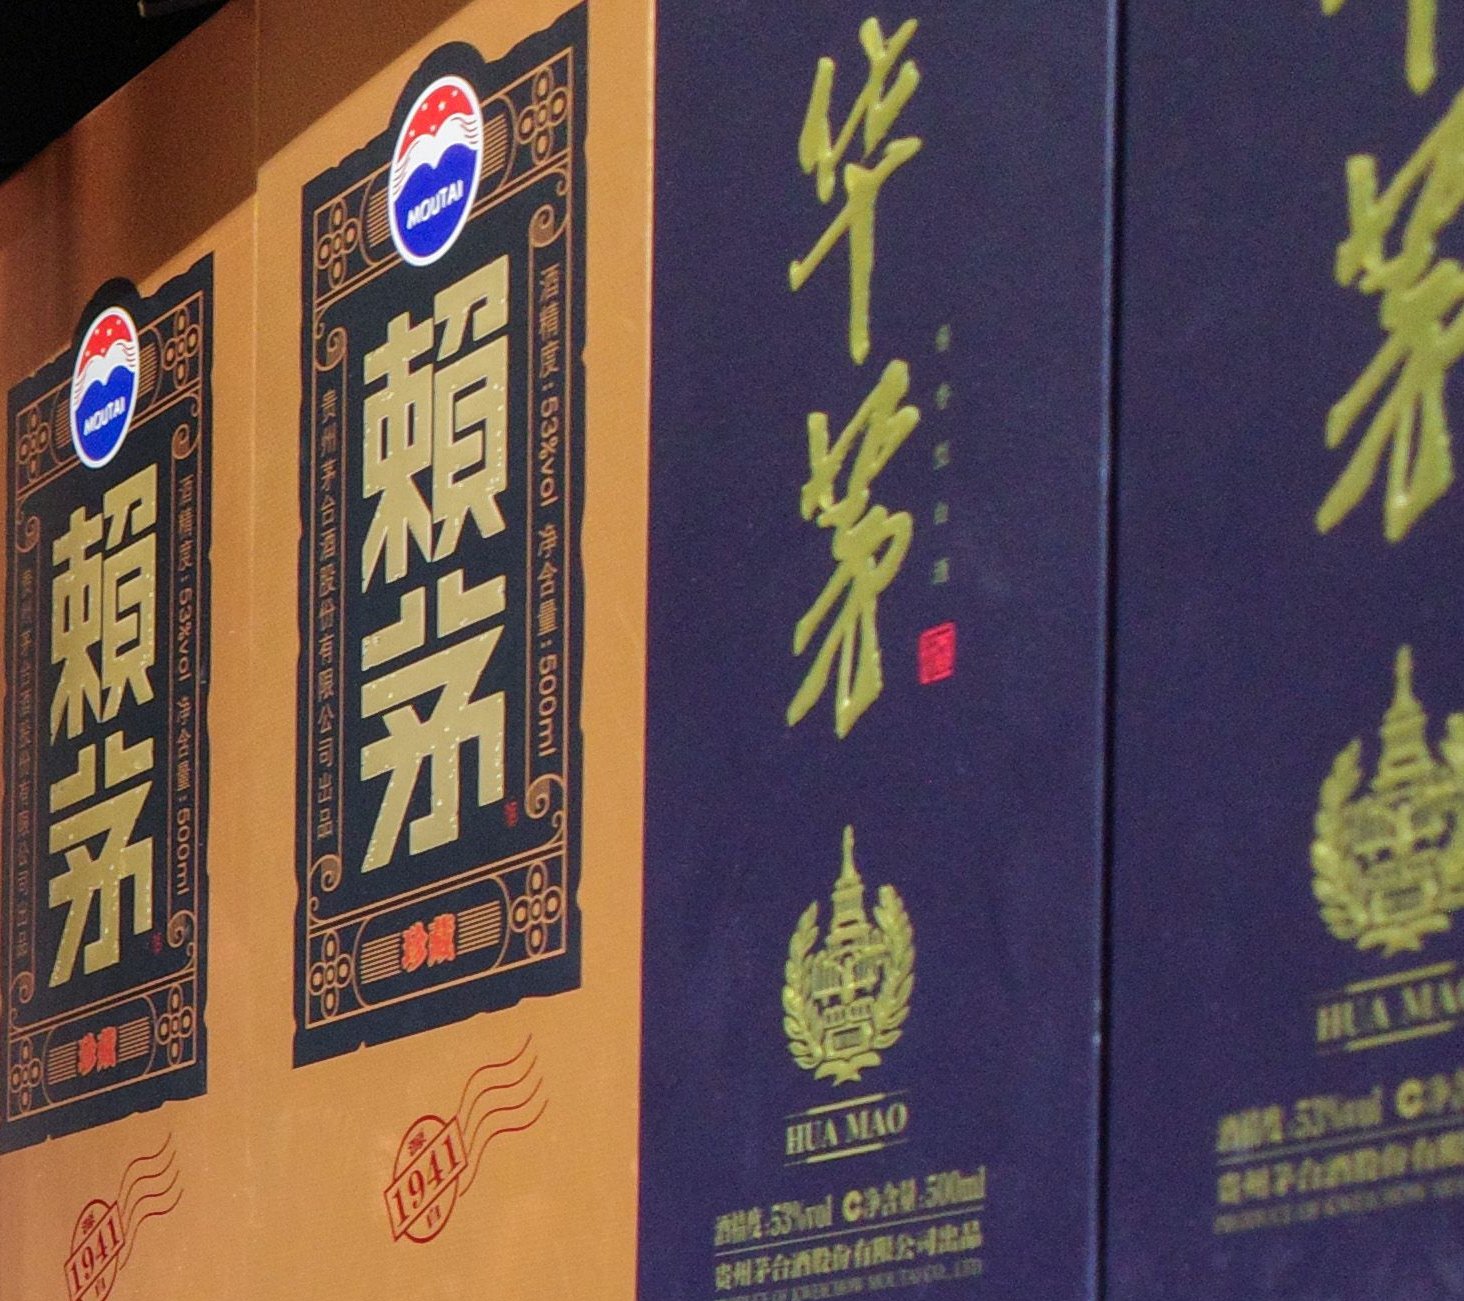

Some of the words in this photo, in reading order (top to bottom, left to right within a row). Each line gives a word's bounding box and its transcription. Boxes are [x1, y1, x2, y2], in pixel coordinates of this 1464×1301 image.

[406, 179, 465, 230] MOUTAI
[82, 395, 127, 437] MOUTAI
[785, 1117, 839, 1156] HUA
[845, 1102, 909, 1144] MAO
[391, 1133, 463, 1228] 1941
[71, 1223, 122, 1295] 1941
